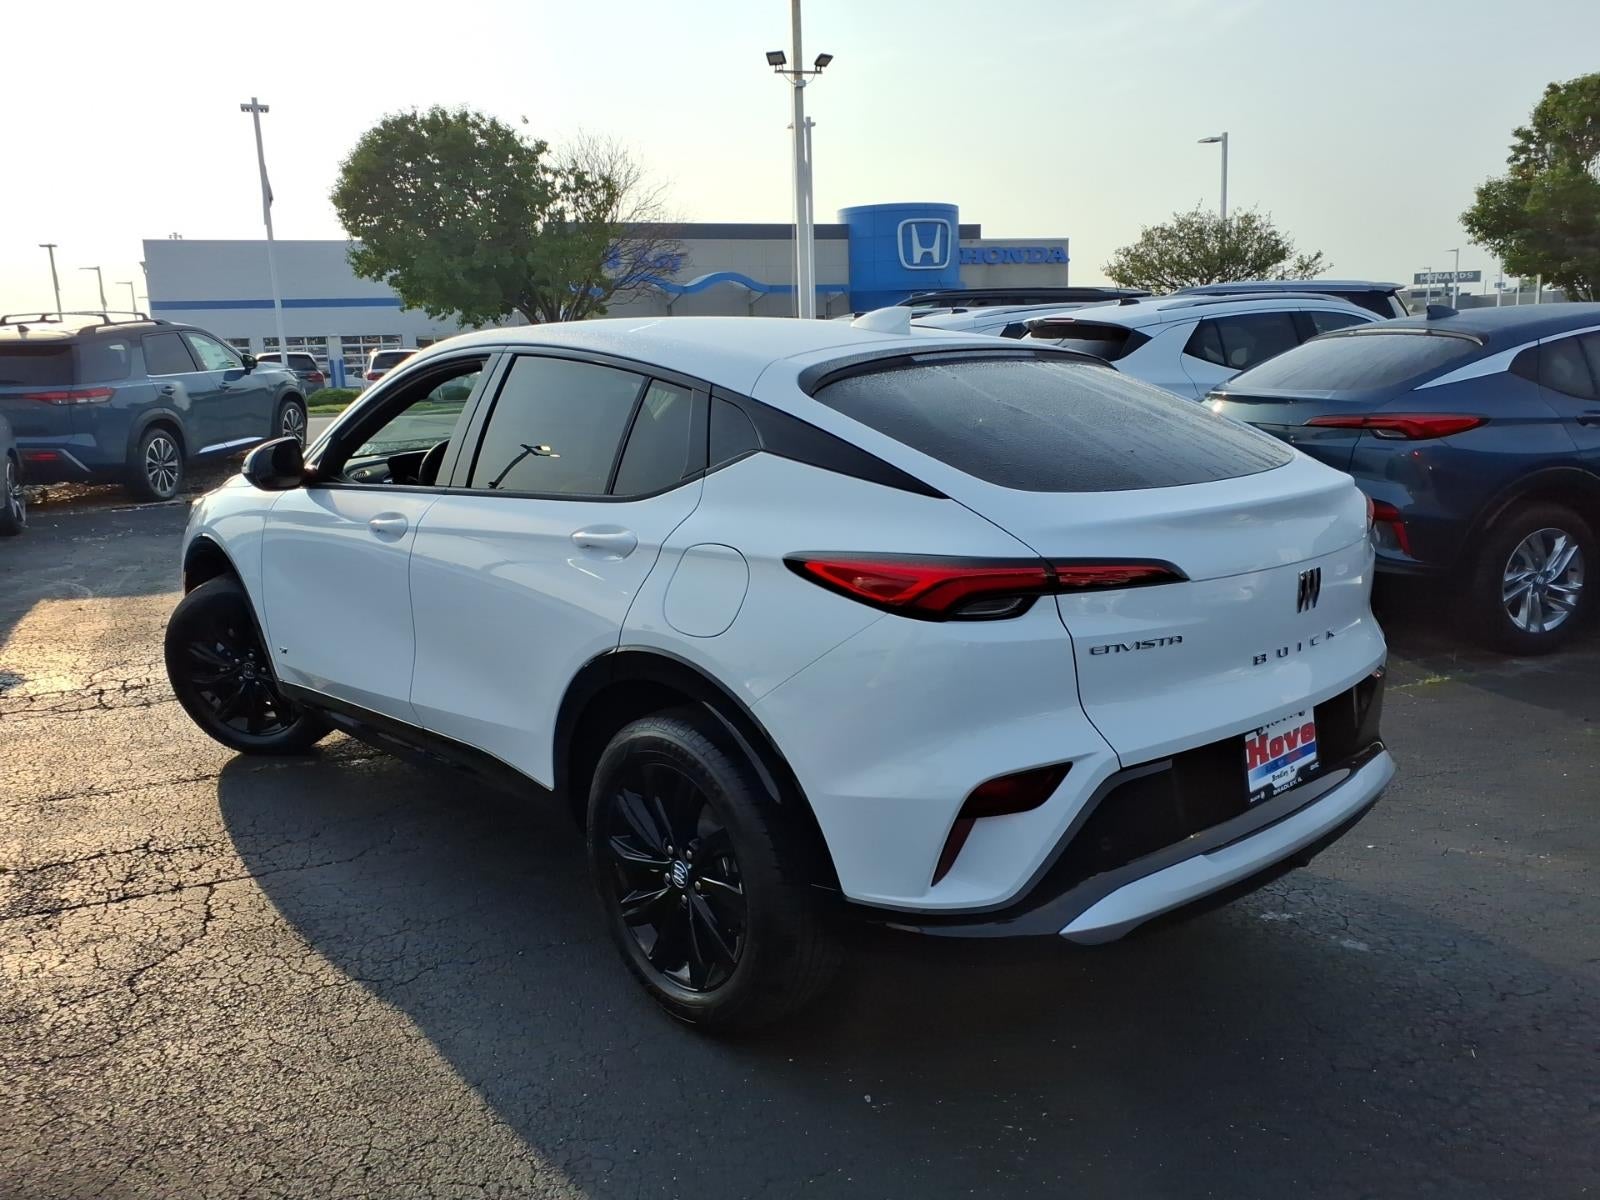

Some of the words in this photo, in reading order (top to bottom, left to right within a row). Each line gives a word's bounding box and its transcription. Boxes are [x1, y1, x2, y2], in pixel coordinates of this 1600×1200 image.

[959, 246, 1070, 265] HONDA
[1089, 635, 1183, 656] ENVISTA
[1252, 630, 1336, 666] BUICK
